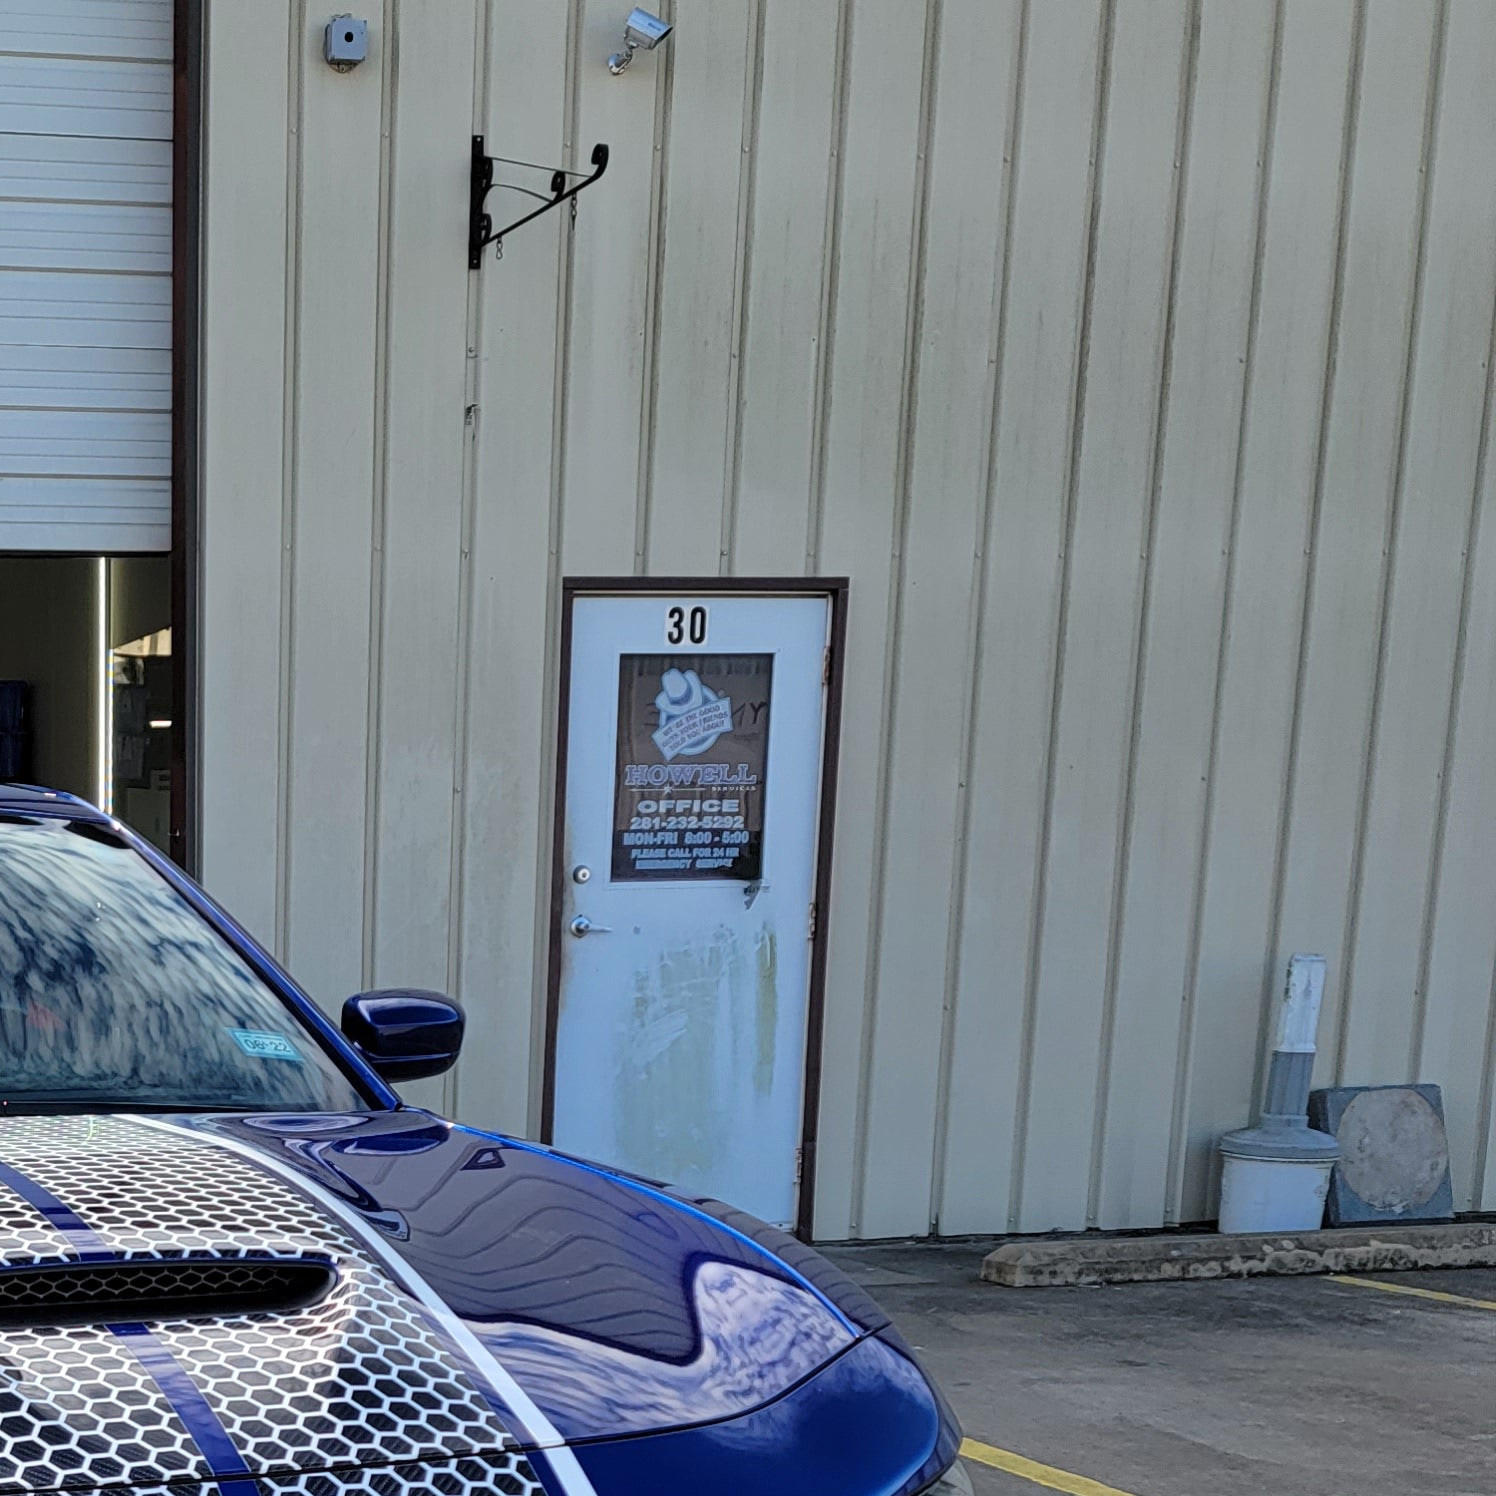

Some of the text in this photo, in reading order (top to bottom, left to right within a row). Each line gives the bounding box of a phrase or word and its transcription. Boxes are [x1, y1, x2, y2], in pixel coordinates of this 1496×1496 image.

[668, 606, 707, 645] 30
[699, 704, 721, 716] GOOD
[624, 763, 758, 785] HOWELL
[637, 799, 740, 813] OFFICE
[630, 815, 745, 830] 281-232-5292
[623, 831, 678, 845] MON-FRI
[667, 847, 691, 858] CALL
